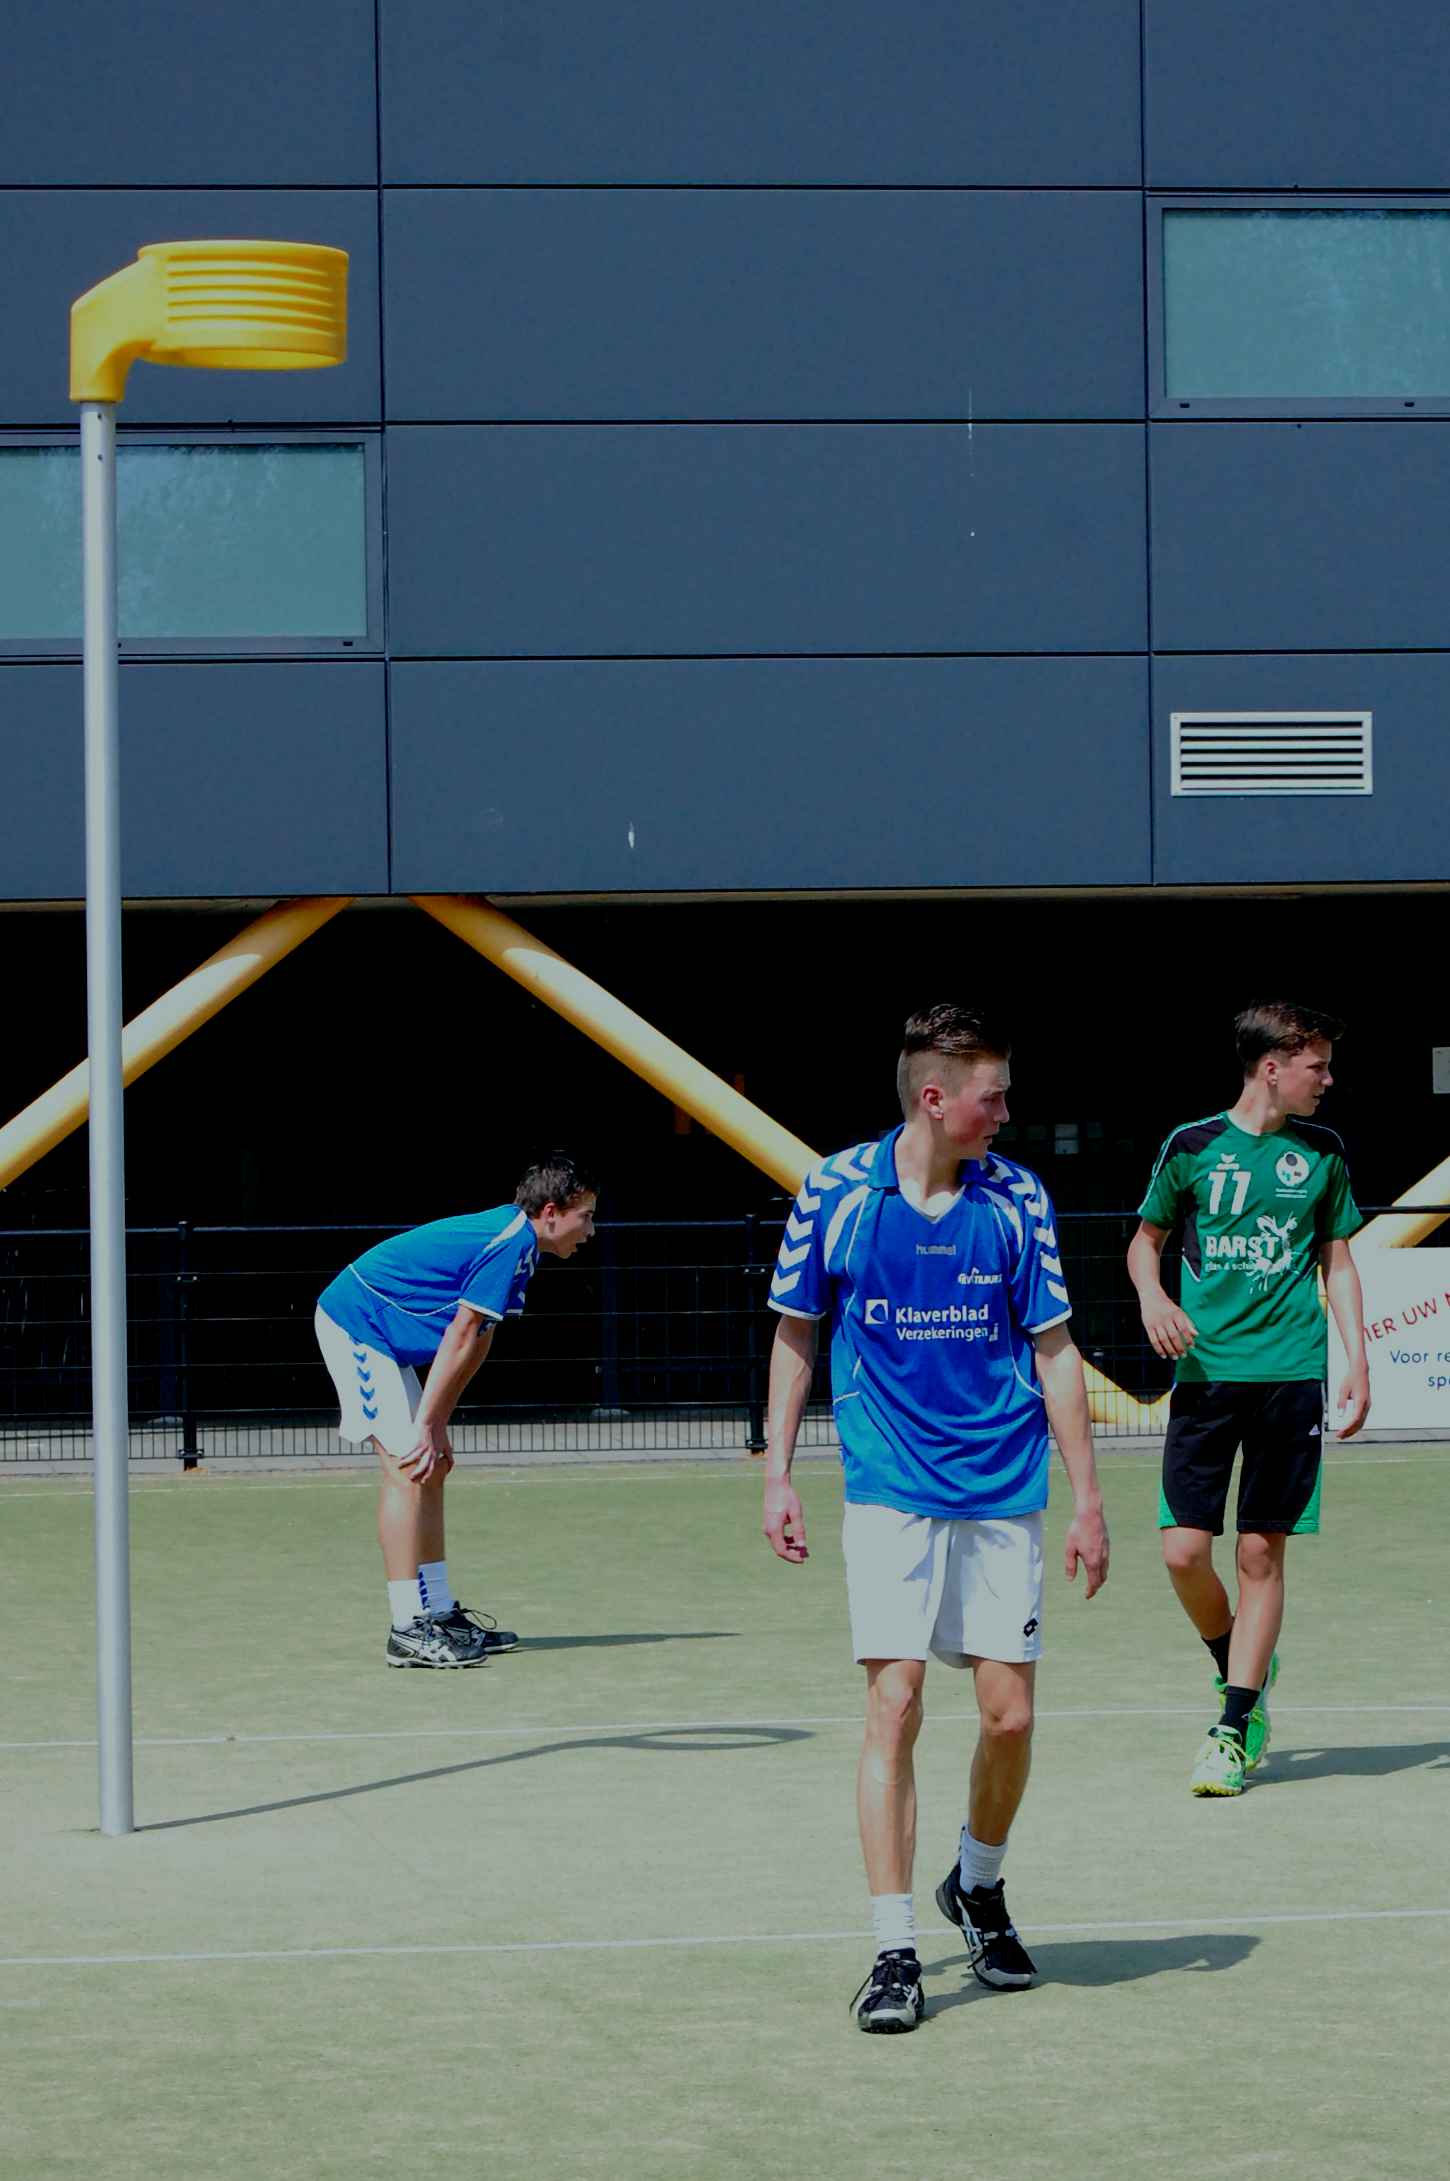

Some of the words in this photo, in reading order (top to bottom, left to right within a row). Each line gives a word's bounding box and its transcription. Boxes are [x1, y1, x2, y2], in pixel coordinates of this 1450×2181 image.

[1208, 1171, 1252, 1215] 11
[1205, 1235, 1280, 1259] BARST
[896, 1304, 989, 1324] Klaverblad
[1363, 1317, 1397, 1342] IER
[1402, 1297, 1437, 1325] UW
[896, 1325, 988, 1342] Verzekeringen
[1390, 1350, 1428, 1363] Voor
[1428, 1376, 1450, 1390] sp
